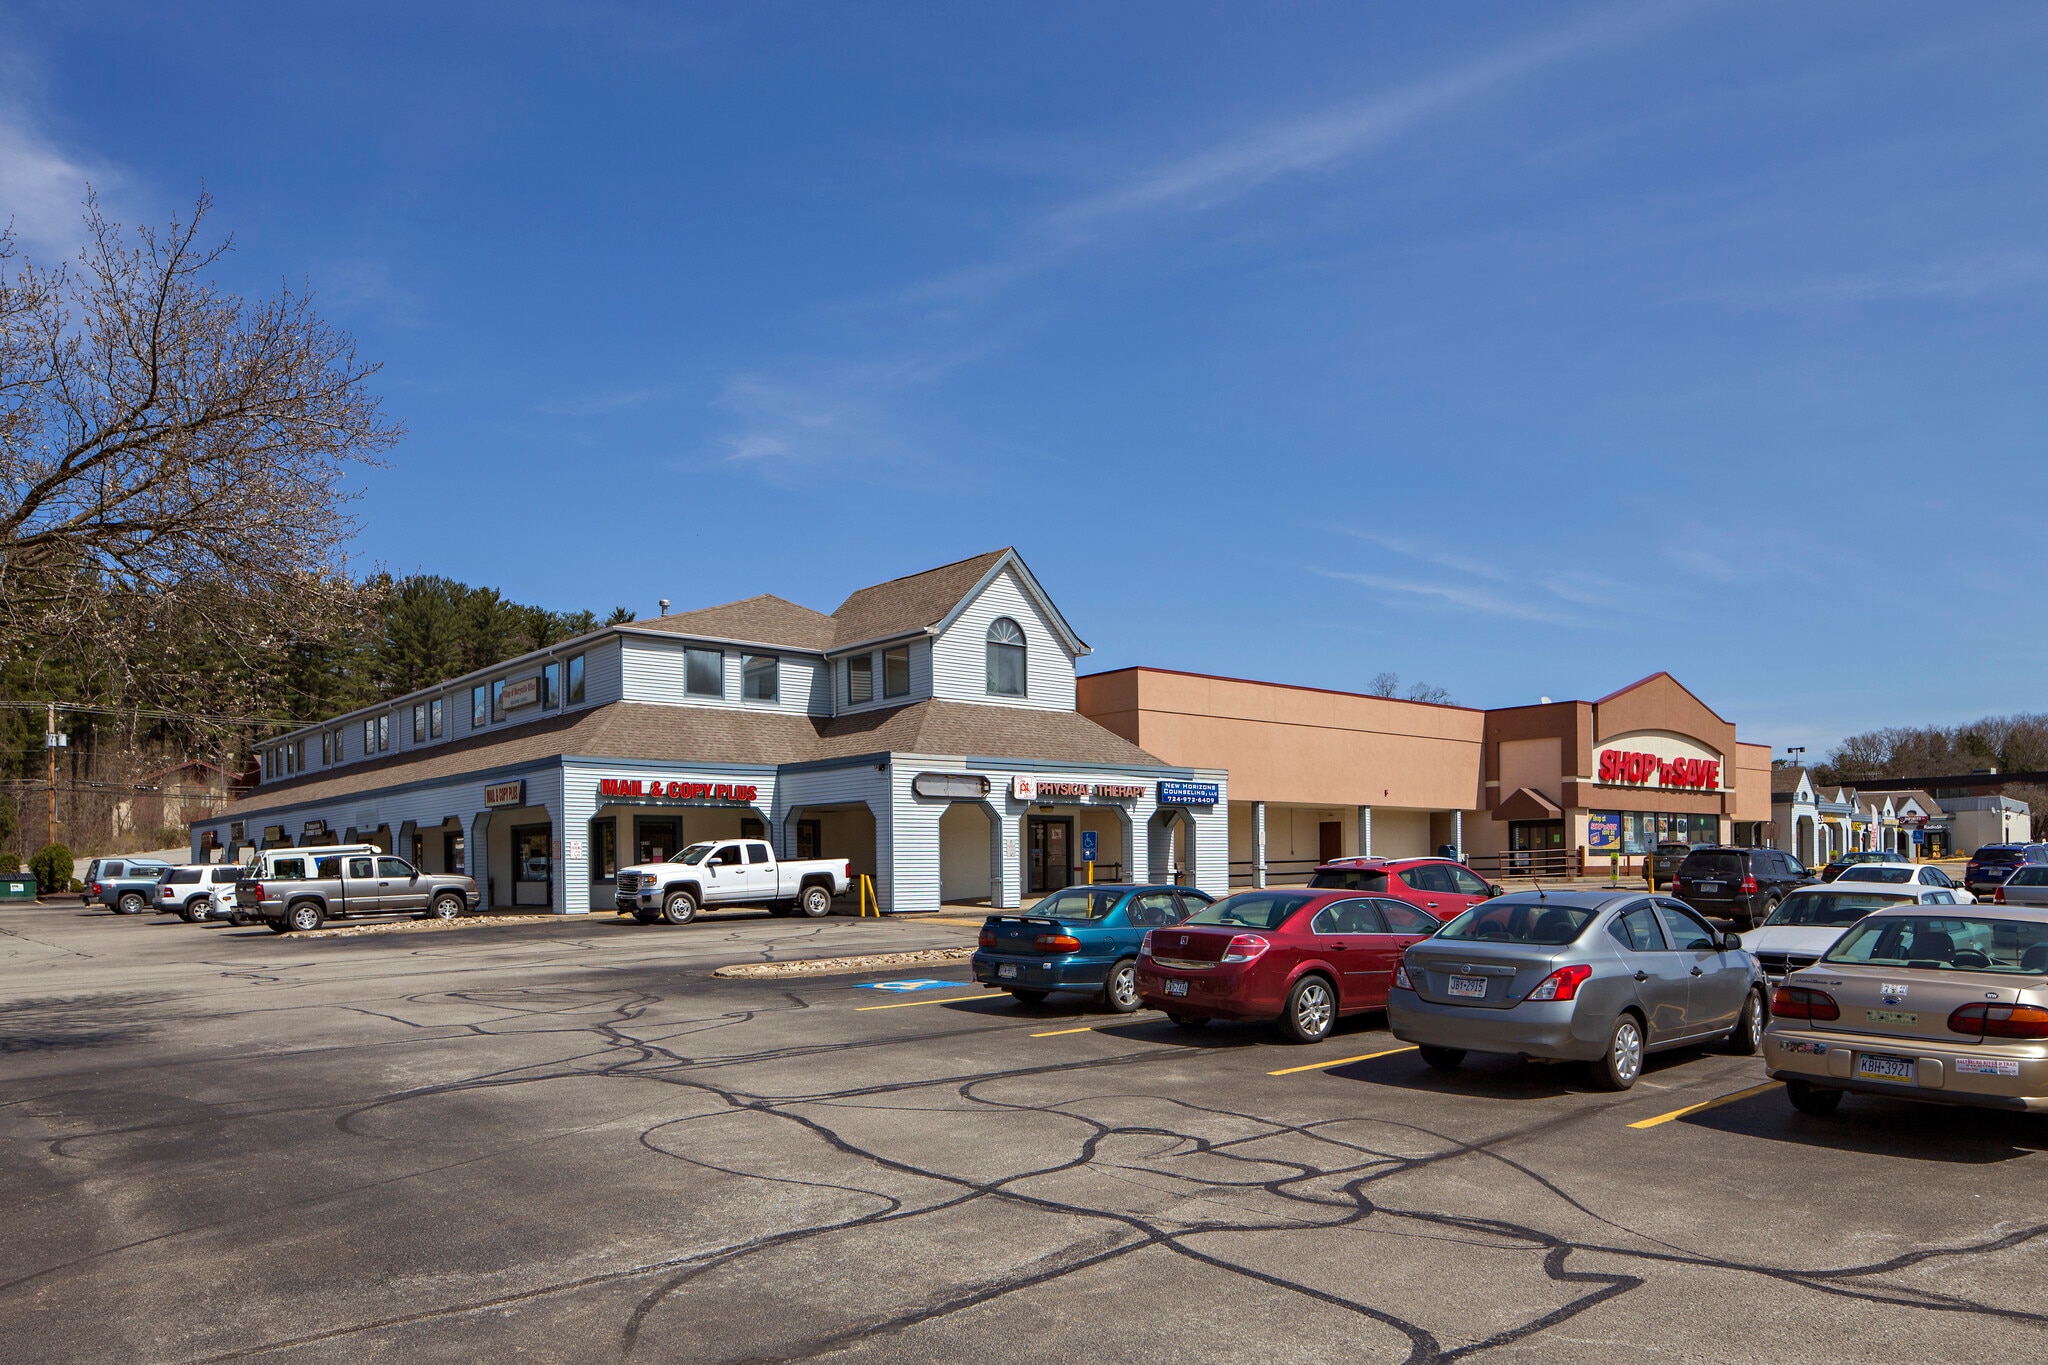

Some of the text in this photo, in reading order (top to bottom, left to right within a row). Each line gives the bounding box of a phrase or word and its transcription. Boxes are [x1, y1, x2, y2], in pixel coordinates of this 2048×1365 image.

[1598, 749, 1657, 783] SHOP
[1673, 757, 1721, 789] SAVE
[601, 779, 758, 801] MAIL & COPY PLUS
[1037, 782, 1147, 798] PHYSICAL THERAPY
